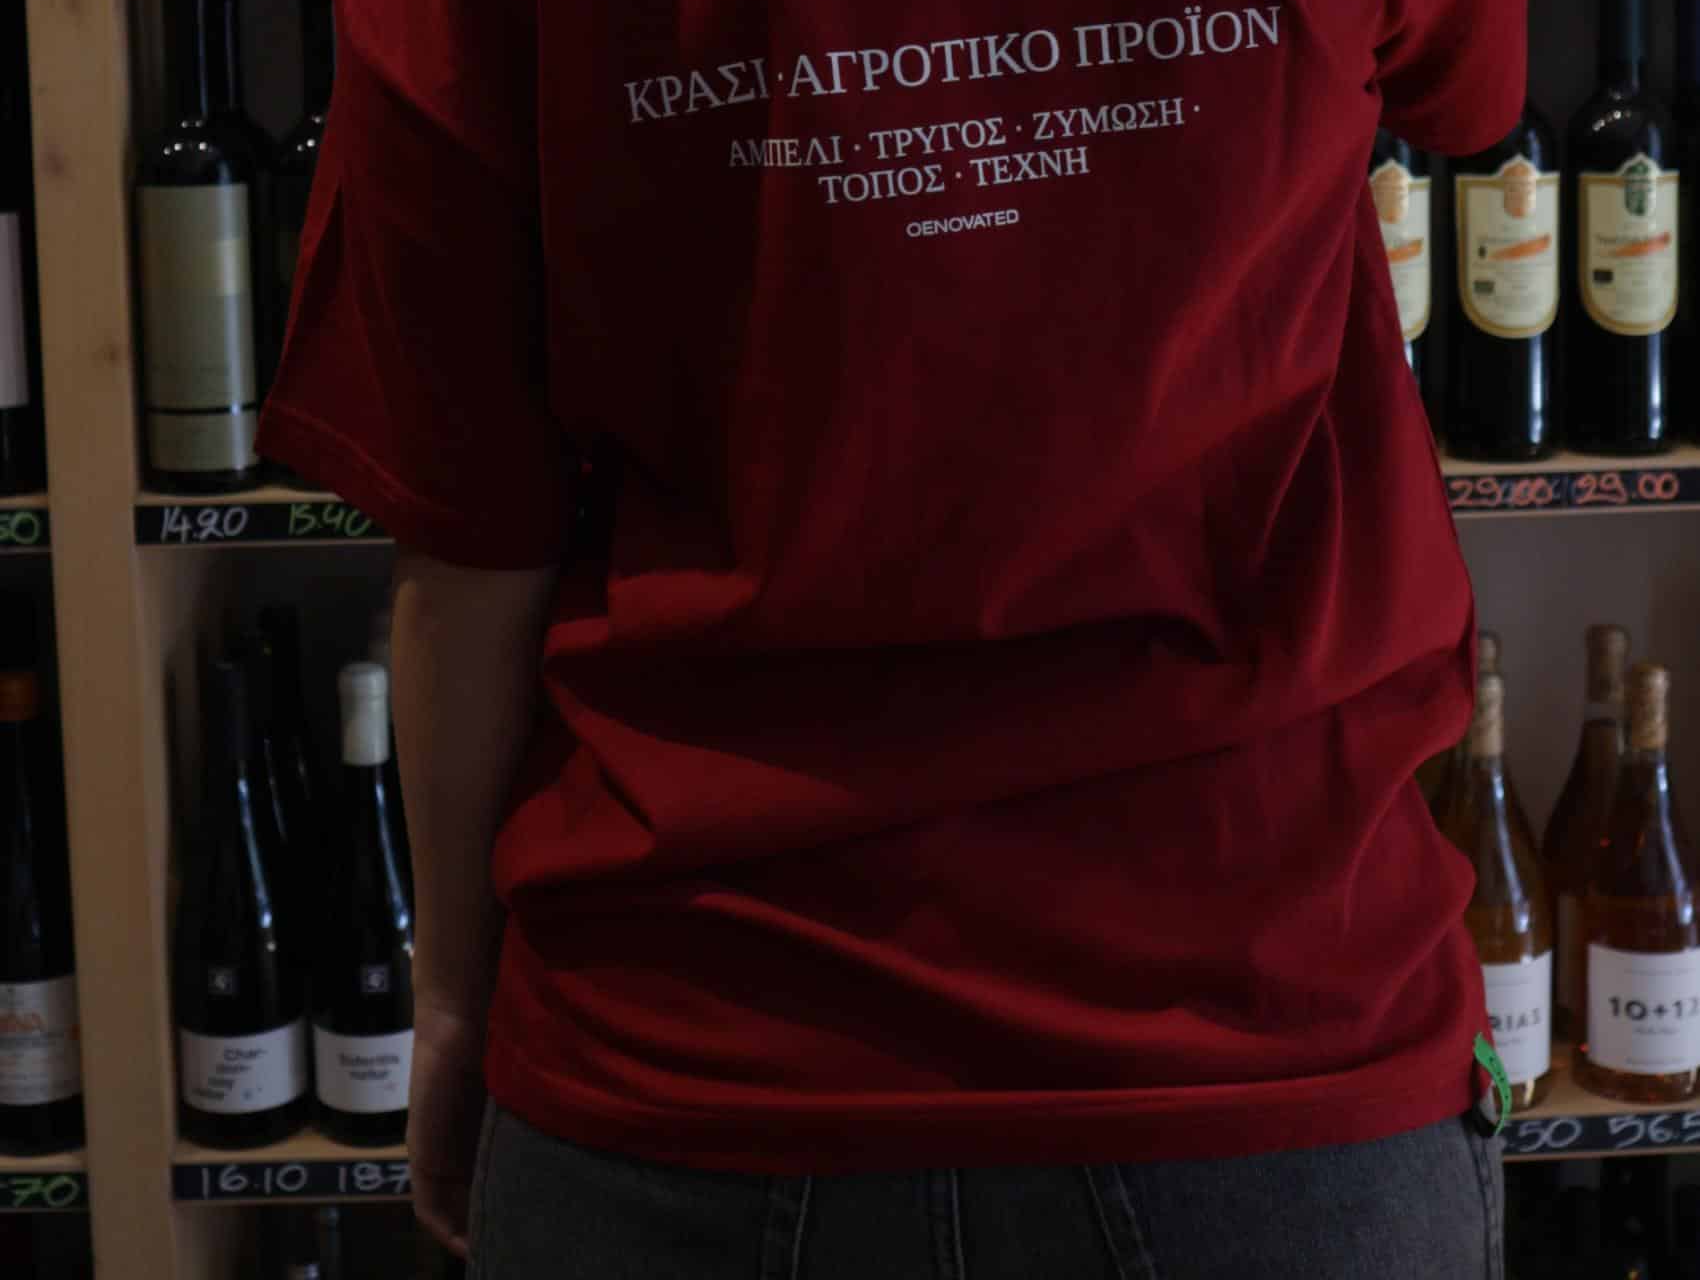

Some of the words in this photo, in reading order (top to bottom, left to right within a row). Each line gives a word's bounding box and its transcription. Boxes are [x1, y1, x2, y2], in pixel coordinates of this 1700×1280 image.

[624, 56, 770, 124] ΚΡΑΣΙ
[1072, 4, 1281, 68] ΠΡΟΪΟΝ
[728, 135, 844, 168] ΑΜΠΕΛΙ
[868, 116, 1006, 161] ΤΡΥΓΟΣ
[1032, 96, 1186, 142] ΖΥΜΩΣΗ
[817, 163, 946, 205] ΤΟΠΟΣ
[968, 145, 1091, 188] ΤΕΧΝΗ
[905, 208, 1021, 238] OENOVATED
[1574, 472, 1680, 505] 29.00
[0, 1174, 80, 1209] 70
[200, 1163, 308, 1199] 16.10
